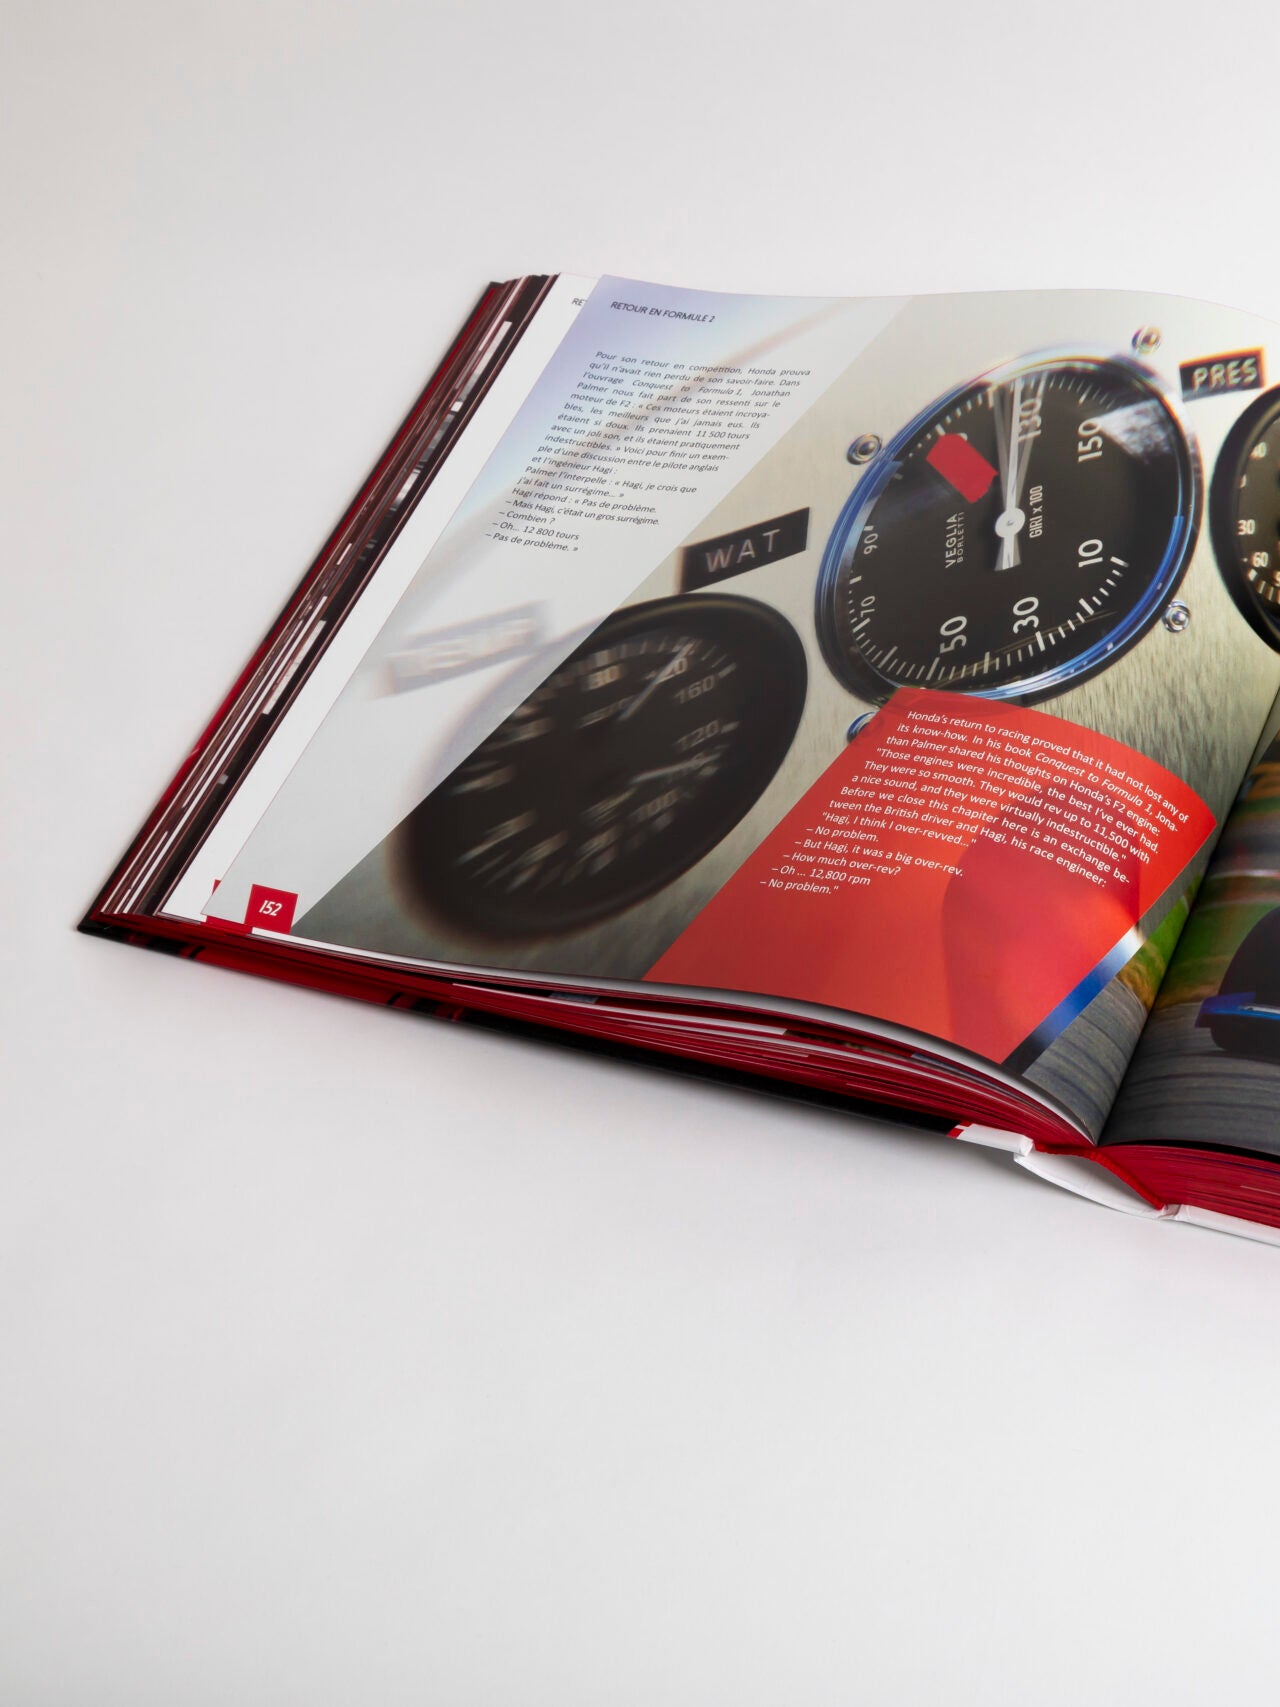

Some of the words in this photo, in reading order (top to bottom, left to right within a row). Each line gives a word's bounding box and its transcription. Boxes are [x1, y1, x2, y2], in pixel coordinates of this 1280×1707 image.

[610, 301, 648, 314] RETOUR
[649, 308, 662, 316] EN
[663, 310, 709, 322] FORMULE
[596, 351, 617, 360] Pour
[641, 359, 670, 368] retour
[1192, 357, 1258, 393] PRES
[1078, 420, 1103, 463] 150
[1030, 486, 1042, 505] 100
[507, 511, 547, 523] Combien
[1029, 516, 1042, 539] GIRI
[1237, 520, 1255, 535] 30
[493, 532, 508, 541] Pas
[511, 536, 522, 544] de
[523, 525, 535, 533] 12
[536, 528, 555, 536] 800
[556, 531, 580, 540] tours
[863, 533, 878, 554] 90
[945, 513, 957, 568] VEGLIA
[957, 511, 965, 563] BORLETTI
[705, 529, 780, 572] WAT
[1078, 539, 1103, 567] 10
[1253, 552, 1268, 568] 60
[860, 595, 875, 618] 70
[1013, 597, 1039, 633] 30
[940, 616, 967, 654] 50
[897, 724, 909, 732] its
[913, 726, 968, 742] know-how.
[972, 736, 982, 744] In
[987, 738, 1001, 749] his
[1005, 742, 1032, 758] book
[1035, 752, 1085, 777] Conquest
[1088, 773, 1099, 783] to
[1101, 779, 1142, 807] Formula
[1145, 804, 1152, 815] 1,
[1155, 811, 1178, 832] Jona-
[949, 718, 982, 730] return
[985, 724, 995, 733] to
[998, 728, 1030, 744] racing
[1032, 738, 1071, 756] proved
[1072, 750, 1094, 765] that
[1095, 759, 1102, 769] it
[1105, 764, 1125, 780] had
[1126, 775, 1143, 790] not
[1145, 786, 1162, 803] lost
[1162, 797, 1179, 816] any
[1178, 810, 1189, 823] of
[887, 736, 909, 746] than
[911, 739, 949, 752] Palmer
[948, 745, 985, 760] shared
[986, 751, 1001, 763] his
[1003, 758, 1051, 779] thoughts
[1053, 775, 1067, 785] on
[1113, 802, 1124, 813] F2
[1126, 809, 1160, 836] engine:
[865, 761, 888, 772] They
[890, 765, 916, 775] were
[932, 771, 976, 787] smooth.
[980, 781, 1006, 796] They
[1008, 790, 1043, 808] would
[1044, 804, 1062, 815] rev
[1064, 811, 1078, 822] up
[1080, 817, 1091, 828] to
[1094, 823, 1129, 848] 11,500
[1130, 844, 1150, 864] with
[877, 748, 910, 760] "Those
[913, 753, 953, 767] engines
[957, 761, 984, 774] were
[987, 769, 1043, 794] incredible,
[1048, 787, 1065, 800] the
[1069, 795, 1092, 812] best
[1116, 820, 1138, 838] ever
[1140, 834, 1159, 854] had.
[815, 826, 830, 836] No
[832, 828, 879, 843] problem.
[792, 853, 815, 863] How
[818, 855, 847, 867] much
[849, 860, 901, 875] over-rev?
[803, 839, 821, 849] But
[824, 841, 848, 853] Hagi,
[852, 845, 860, 854] it
[863, 848, 883, 858] was
[895, 851, 912, 865] big
[914, 857, 963, 877] over-rev.
[768, 879, 783, 888] No
[785, 881, 838, 895] problem."
[781, 866, 795, 875] Oh
[809, 868, 846, 881] 12,800
[848, 875, 870, 886] rpm
[258, 900, 283, 917] 152
